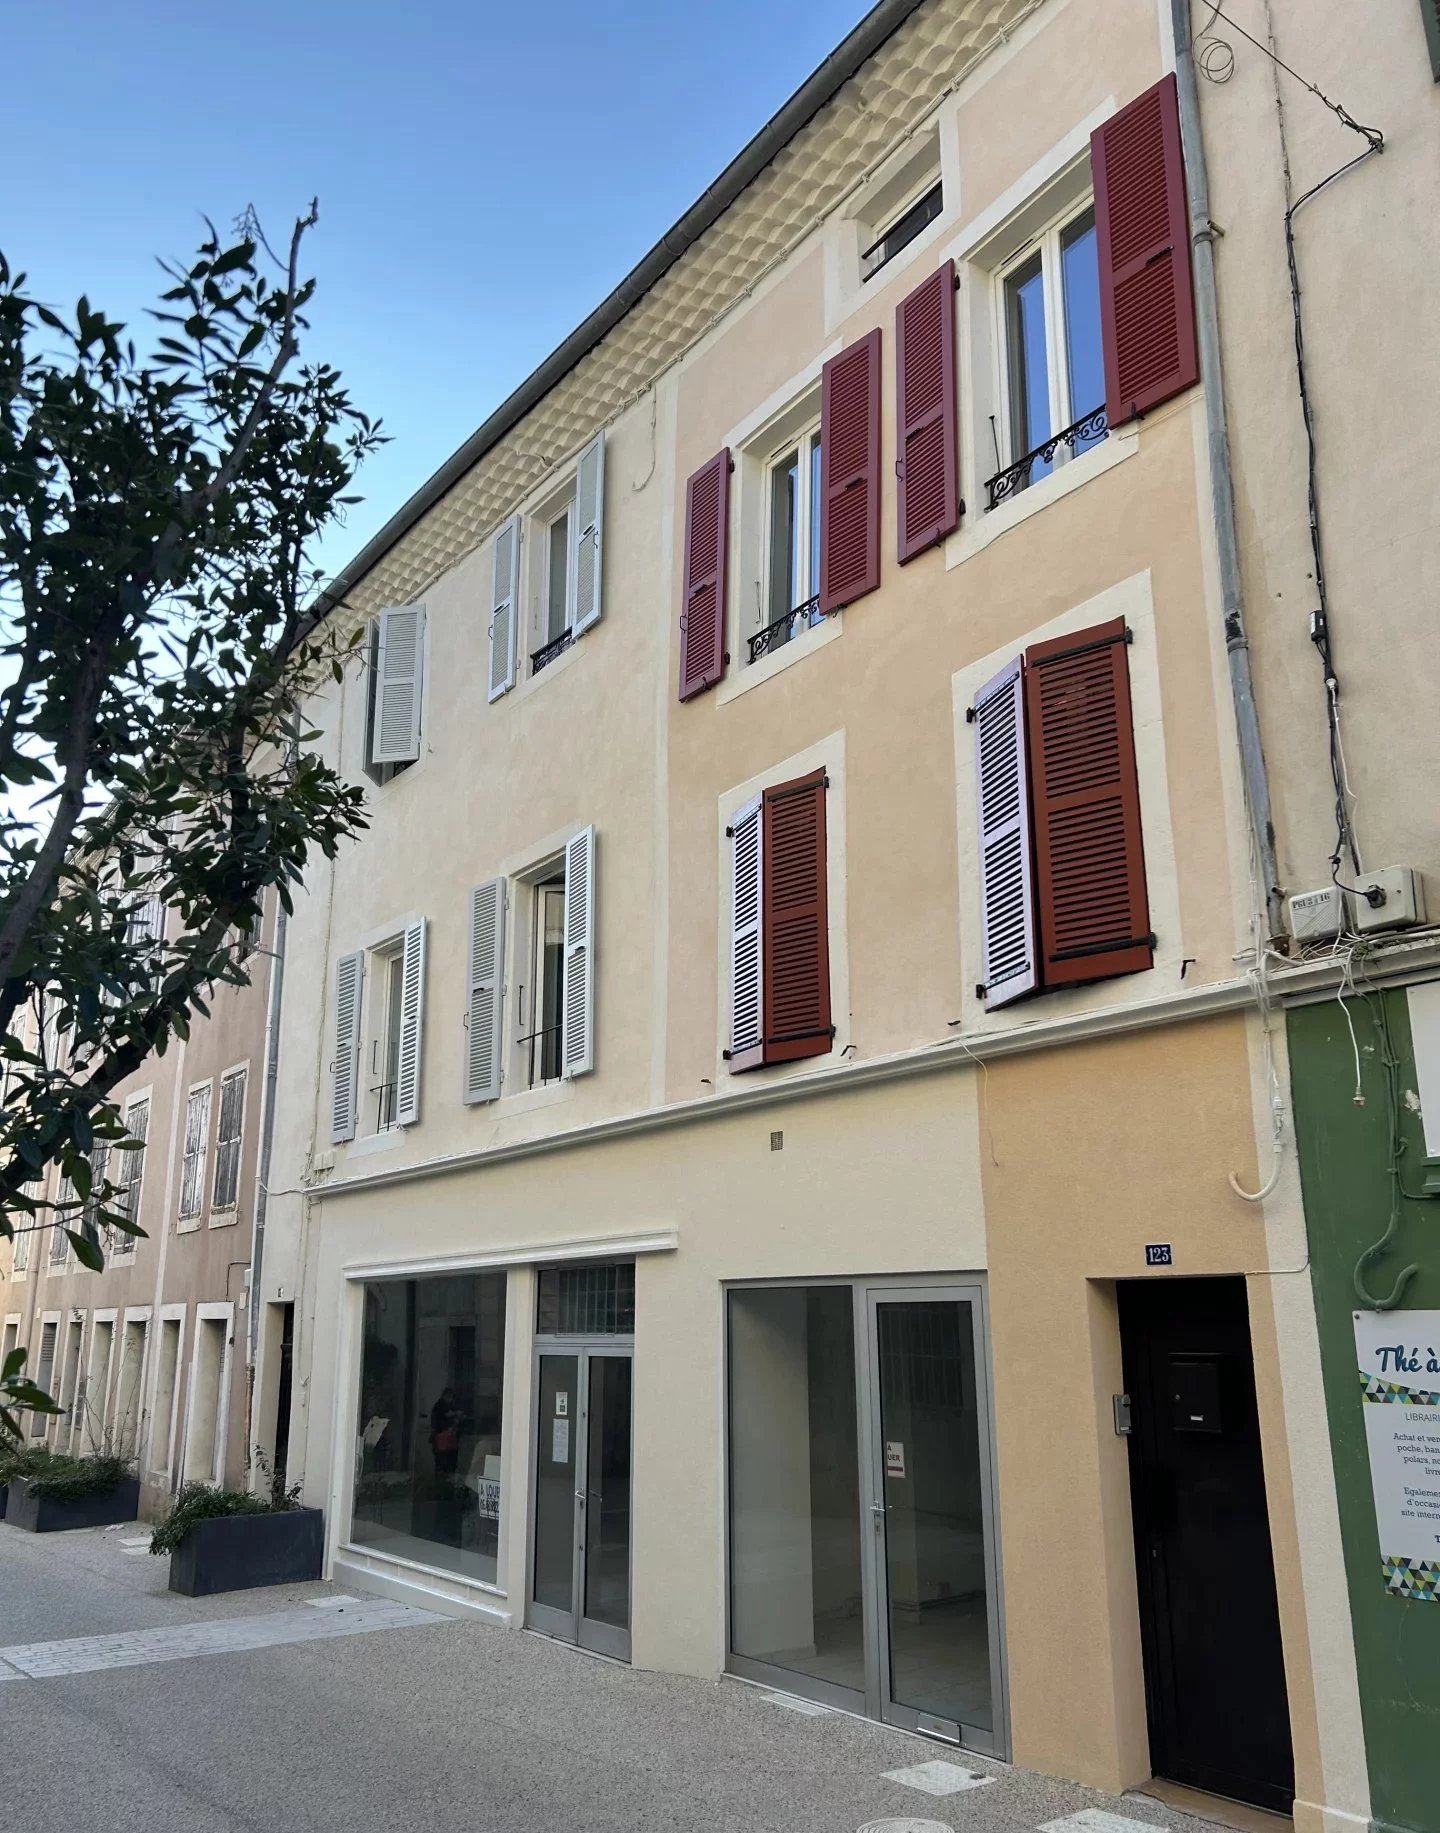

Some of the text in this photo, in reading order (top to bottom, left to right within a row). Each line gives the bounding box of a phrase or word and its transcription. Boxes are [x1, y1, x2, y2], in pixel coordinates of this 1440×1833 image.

[1149, 1247, 1169, 1262] 123
[1375, 1344, 1440, 1373] Thé à
[1393, 1432, 1416, 1441] Achat
[1397, 1445, 1424, 1453] poche,
[1404, 1456, 1430, 1464] polars,
